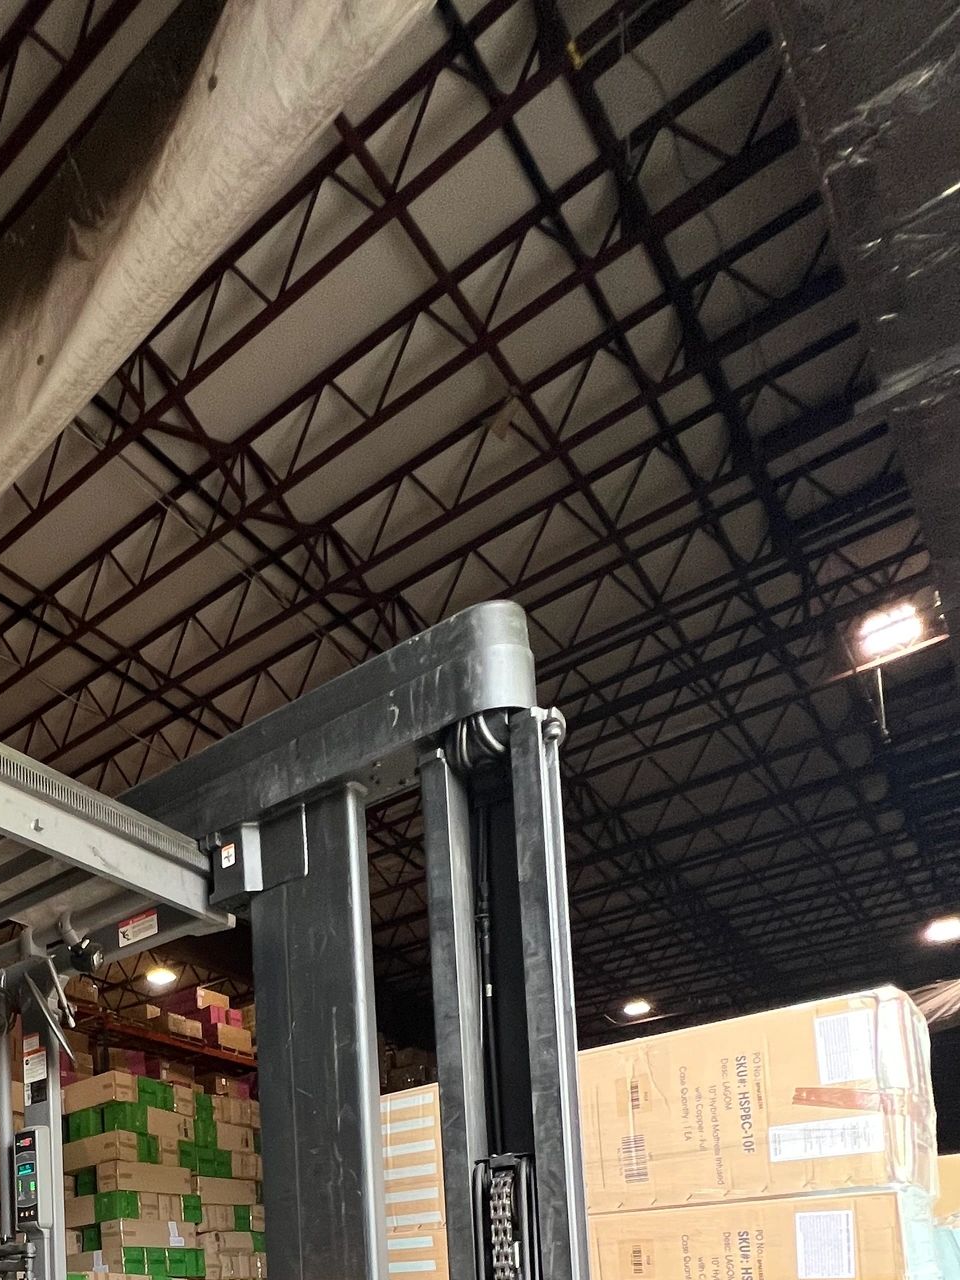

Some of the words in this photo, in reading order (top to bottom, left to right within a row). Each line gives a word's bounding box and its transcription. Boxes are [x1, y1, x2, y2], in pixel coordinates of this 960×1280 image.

[736, 1056, 748, 1088] SKU#:
[722, 1082, 732, 1111] LAGOM
[738, 1092, 755, 1153] HSPBC-10F
[738, 1231, 751, 1263] SKU#:
